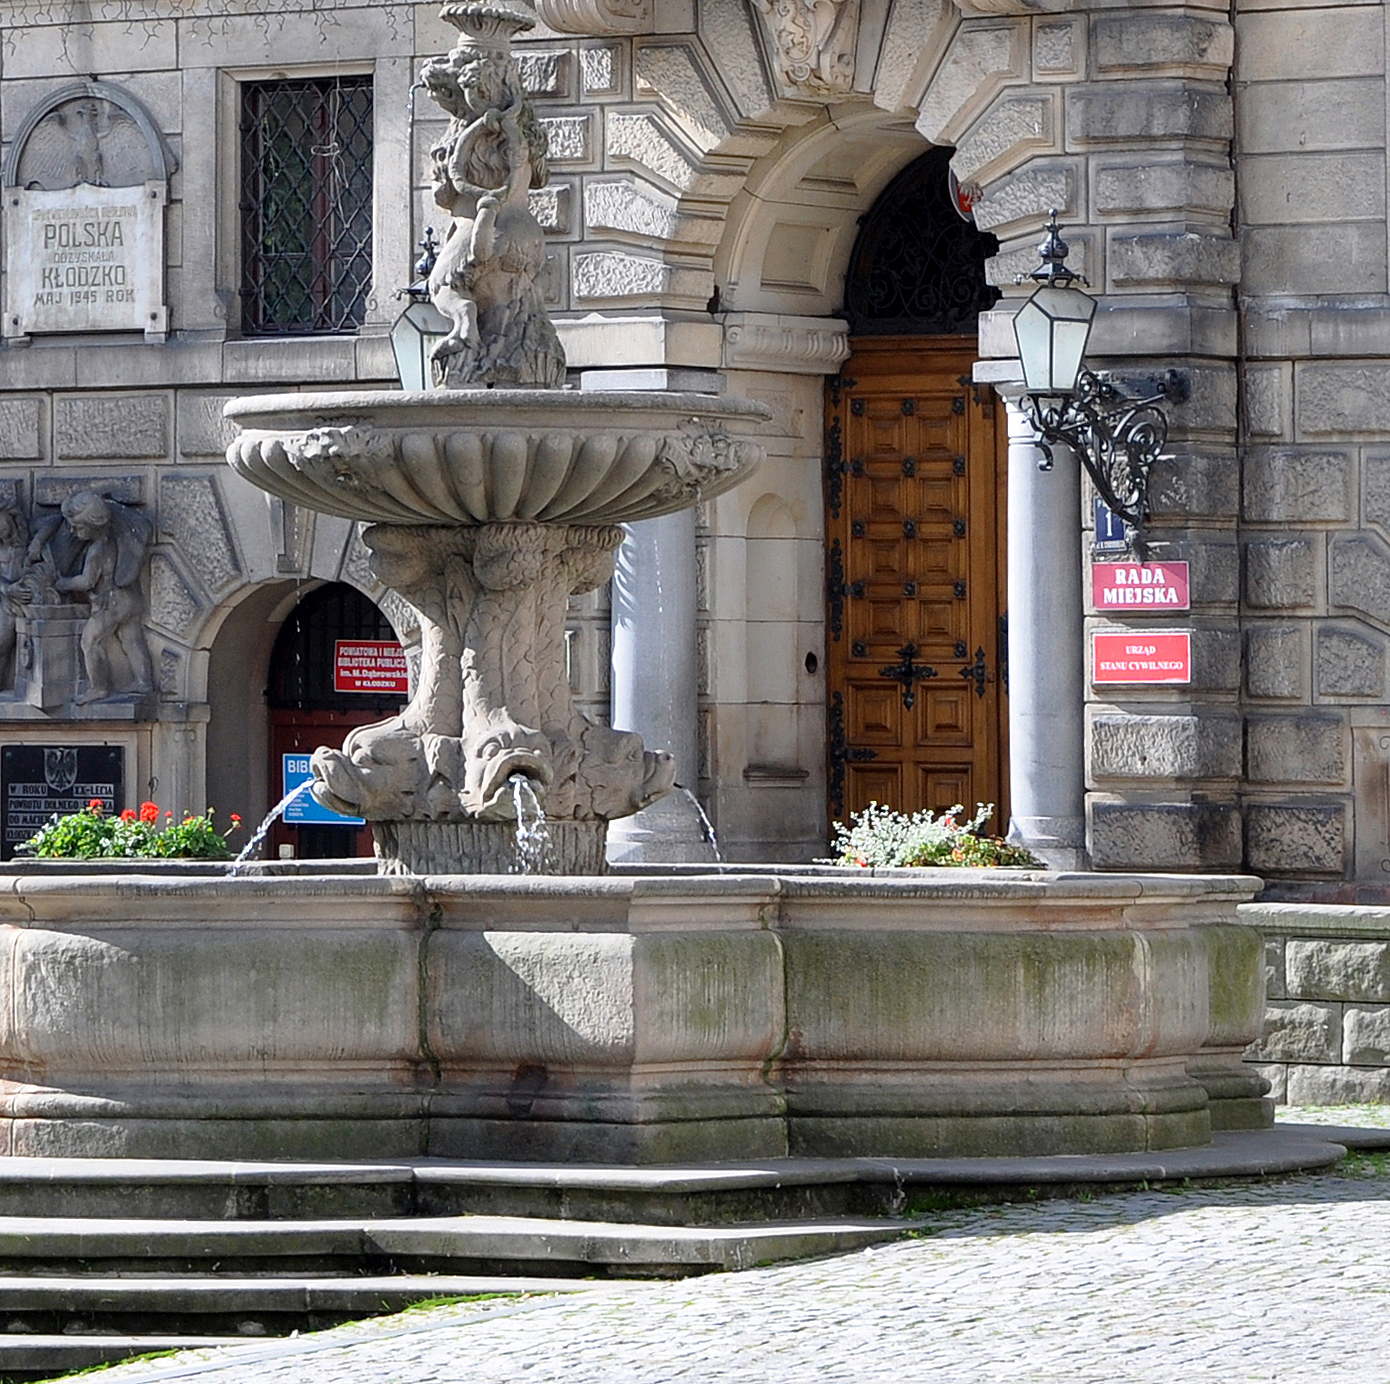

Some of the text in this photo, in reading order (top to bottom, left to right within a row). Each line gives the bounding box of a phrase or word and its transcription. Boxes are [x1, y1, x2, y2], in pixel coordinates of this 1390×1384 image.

[44, 221, 123, 249] POLSKA
[53, 251, 115, 264] ODZYSKAŁA
[42, 265, 125, 289] KŁODZKO
[34, 289, 135, 306] MAJ 1945 ROK
[1106, 512, 1113, 536] 1
[1115, 568, 1165, 584] RADA
[1103, 587, 1179, 604] MIEJSKA
[383, 647, 404, 657] MIEJS
[1126, 646, 1156, 656] URZĄD
[377, 658, 406, 668] PUBLICZ
[1100, 661, 1183, 670] STANU CYWILNEGO
[10, 785, 16, 794] W
[23, 785, 47, 795] ROKU
